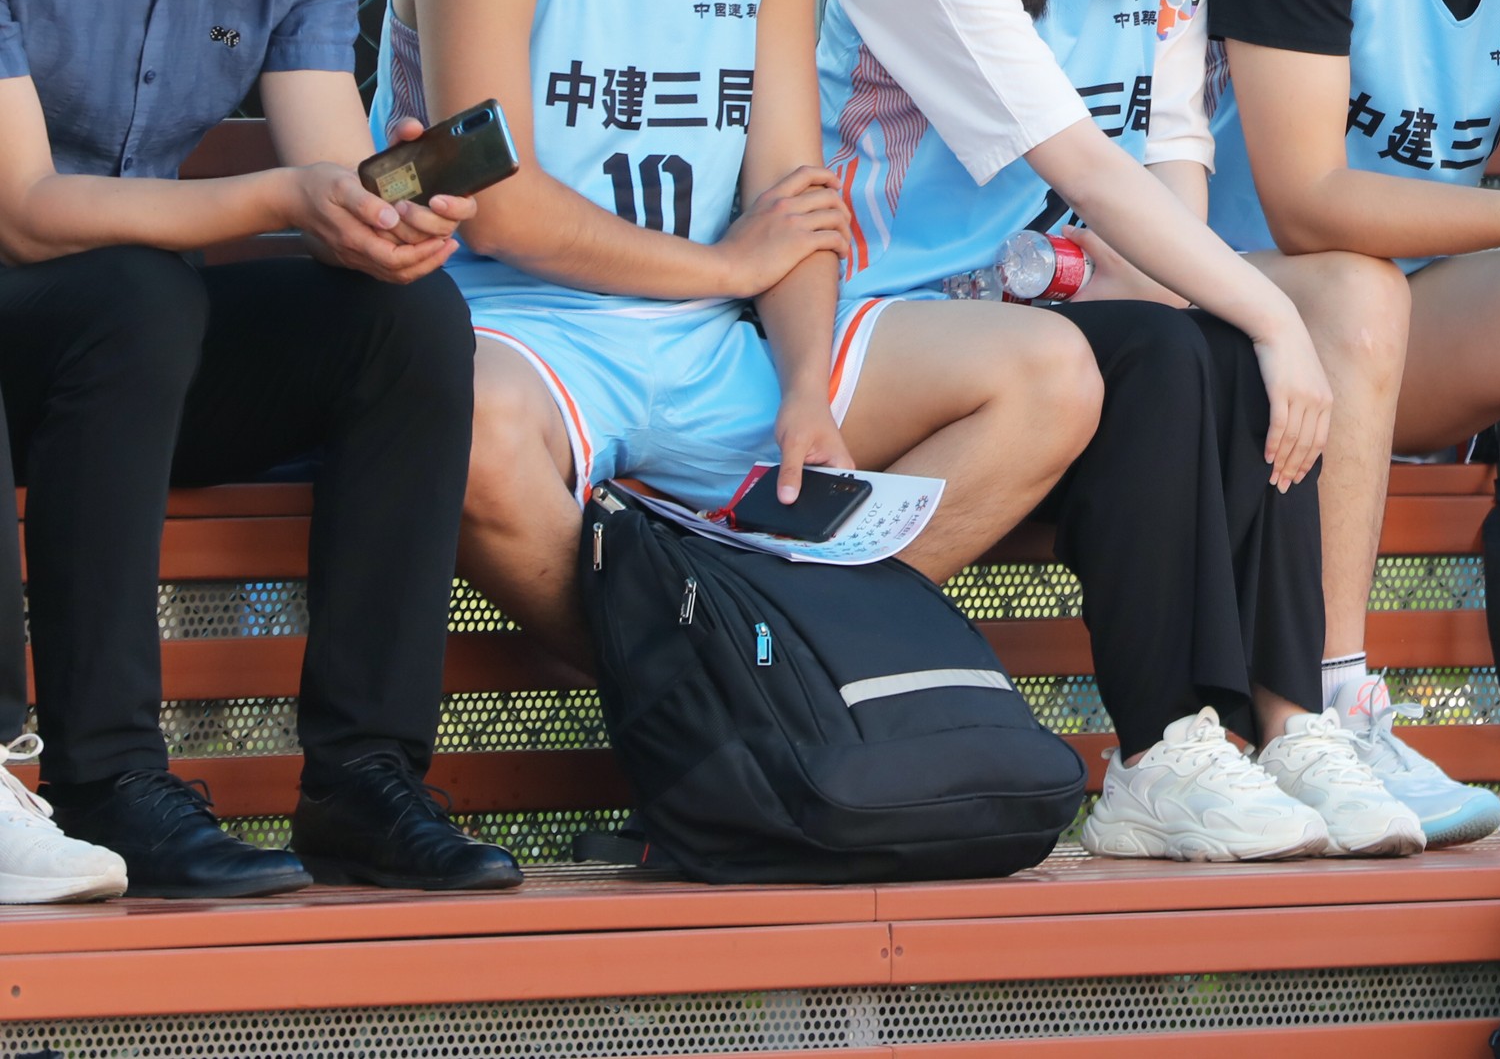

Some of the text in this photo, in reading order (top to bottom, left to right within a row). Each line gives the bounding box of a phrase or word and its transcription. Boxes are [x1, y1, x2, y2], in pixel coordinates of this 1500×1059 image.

[546, 60, 754, 135] 中建三局
[603, 152, 693, 240] 10
